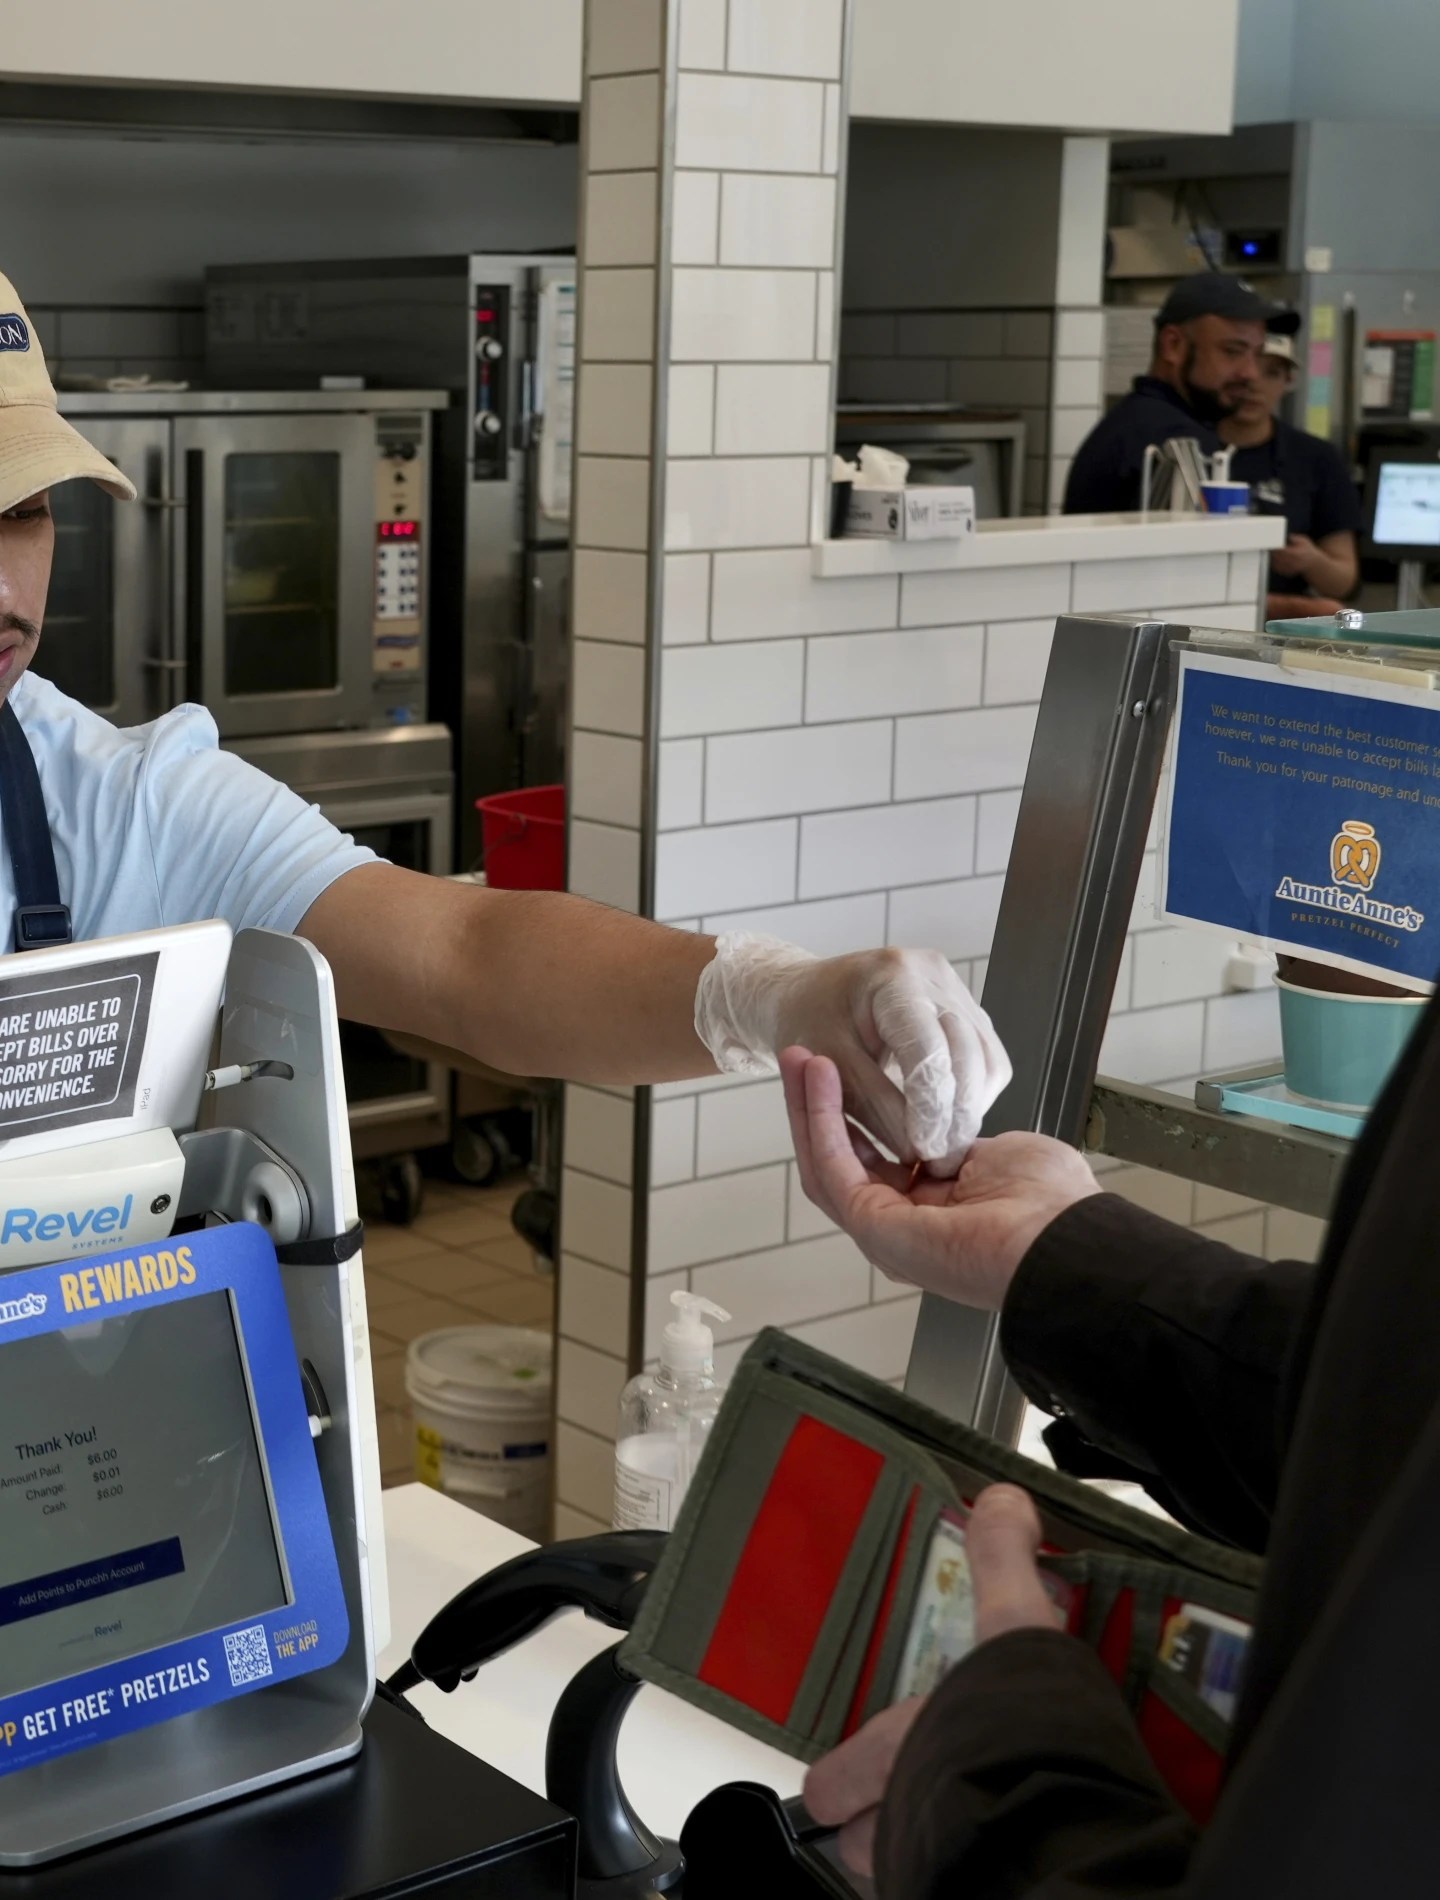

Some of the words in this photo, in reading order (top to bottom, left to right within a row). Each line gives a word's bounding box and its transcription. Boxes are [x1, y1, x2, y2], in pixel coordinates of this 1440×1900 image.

[1210, 703, 1229, 718] We
[1232, 711, 1260, 724] want
[1263, 714, 1276, 727] to
[1279, 718, 1320, 735] extend
[1324, 724, 1343, 740] the
[1347, 726, 1371, 744] best
[1375, 735, 1430, 756] customer
[1205, 721, 1256, 743] however,
[1259, 732, 1276, 745] we
[1279, 738, 1299, 750] are
[1302, 741, 1344, 759] unable
[1347, 748, 1359, 762] to
[1363, 752, 1402, 771] accept
[1405, 759, 1429, 777] bills
[1217, 751, 1252, 769] Thank
[1256, 759, 1277, 774] you
[1281, 762, 1298, 778] for
[1302, 769, 1329, 783] your
[1332, 775, 1393, 799] patronage
[1396, 787, 1420, 803] and
[1291, 912, 1346, 928] PRETZEL
[1349, 922, 1400, 948] PERFECT
[34, 1001, 98, 1031] UNABLE
[102, 997, 122, 1019] TO
[27, 1031, 74, 1058] BILLS
[77, 1022, 120, 1048] OVER
[50, 1053, 84, 1078] FOR
[87, 1046, 118, 1070] THE
[0, 1193, 134, 1245] Revel
[71, 1236, 125, 1250] SYSTEMS
[60, 1246, 197, 1314] REWARDS
[15, 1436, 62, 1461] Thank
[64, 1425, 98, 1448] You!
[0, 1471, 39, 1490] Amount
[87, 1447, 118, 1467] $6.00
[92, 1465, 121, 1484] $0.01
[96, 1483, 124, 1501] $6.00
[18, 1593, 37, 1607] Add
[38, 1584, 65, 1600] Points
[66, 1583, 76, 1593] to
[75, 1572, 110, 1590] Punchh
[109, 1561, 146, 1579] Account
[94, 1619, 123, 1638] Revel
[273, 1619, 318, 1644] DOWNLOAD
[275, 1640, 298, 1660] THE
[298, 1632, 320, 1654] APP
[22, 1706, 58, 1740] GET
[121, 1657, 211, 1708] PRETZELS
